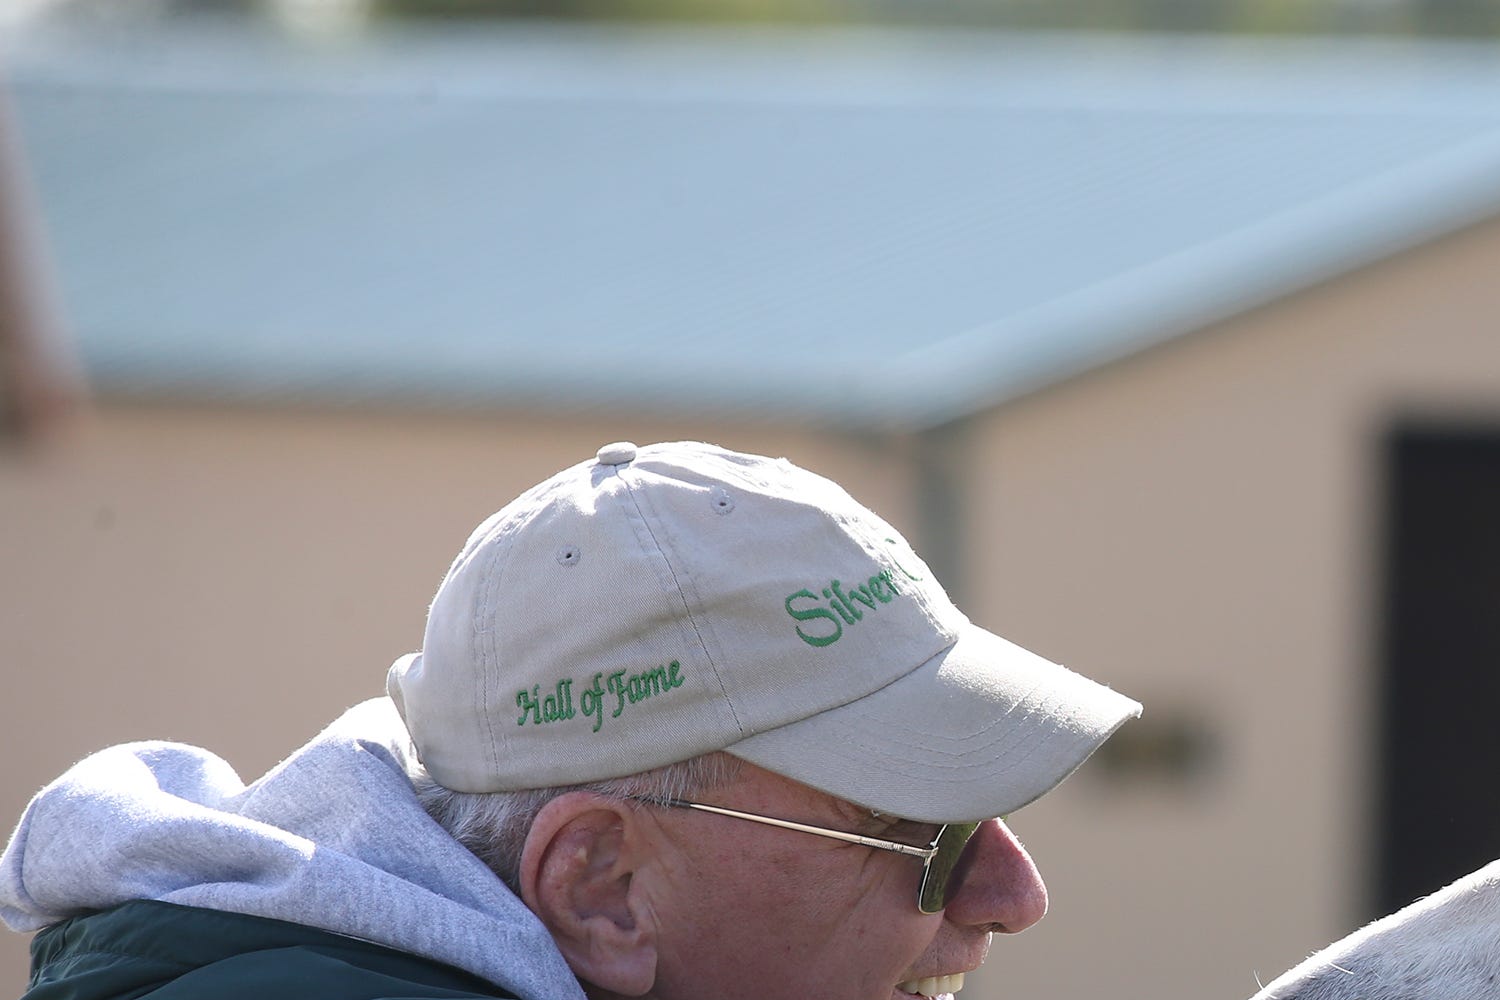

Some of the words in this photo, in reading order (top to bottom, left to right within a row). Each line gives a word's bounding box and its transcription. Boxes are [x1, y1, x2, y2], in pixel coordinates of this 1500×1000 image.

[785, 569, 901, 647] Silver
[516, 678, 576, 727] Hall
[580, 672, 604, 733] of
[607, 659, 686, 719] Fame
